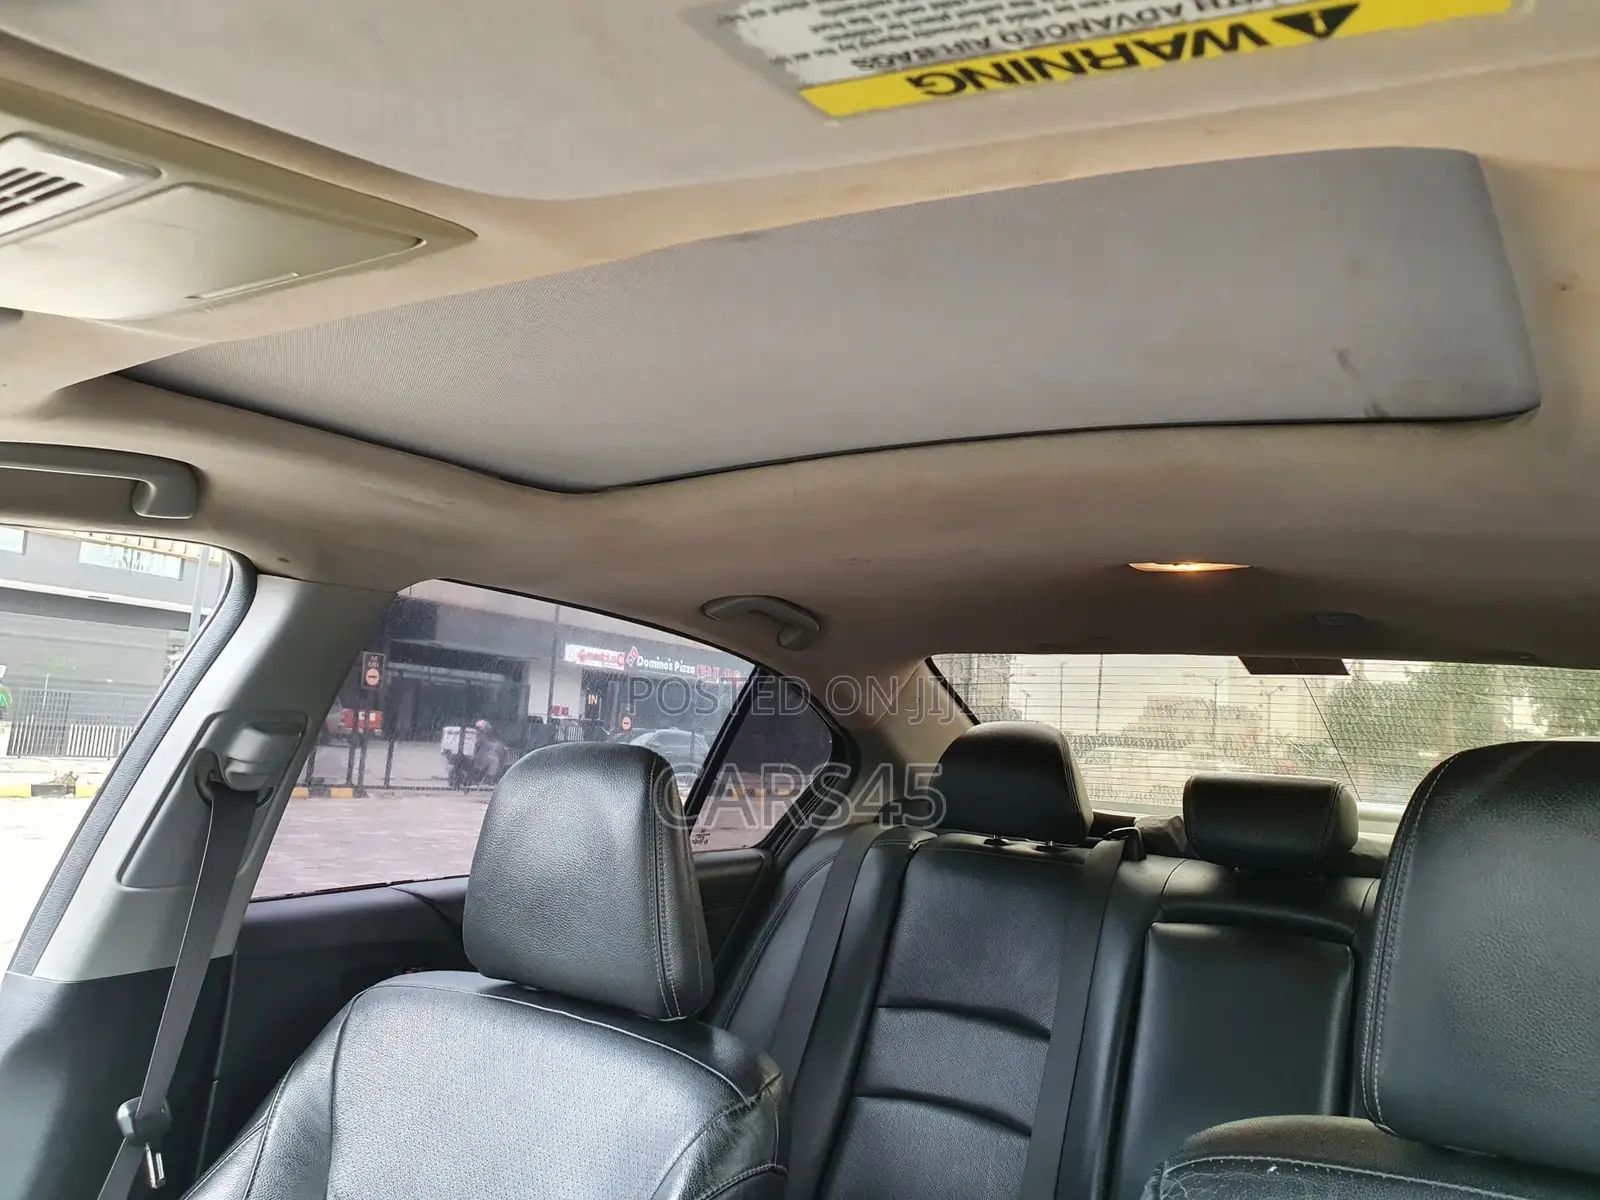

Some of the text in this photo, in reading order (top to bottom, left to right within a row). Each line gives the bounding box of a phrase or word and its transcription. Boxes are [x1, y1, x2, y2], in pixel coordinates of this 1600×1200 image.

[997, 3, 1184, 46] ADVANCED
[905, 24, 1270, 99] WARNING
[636, 655, 673, 670] Domino's
[674, 660, 695, 673] Pizza
[588, 694, 598, 704] IN
